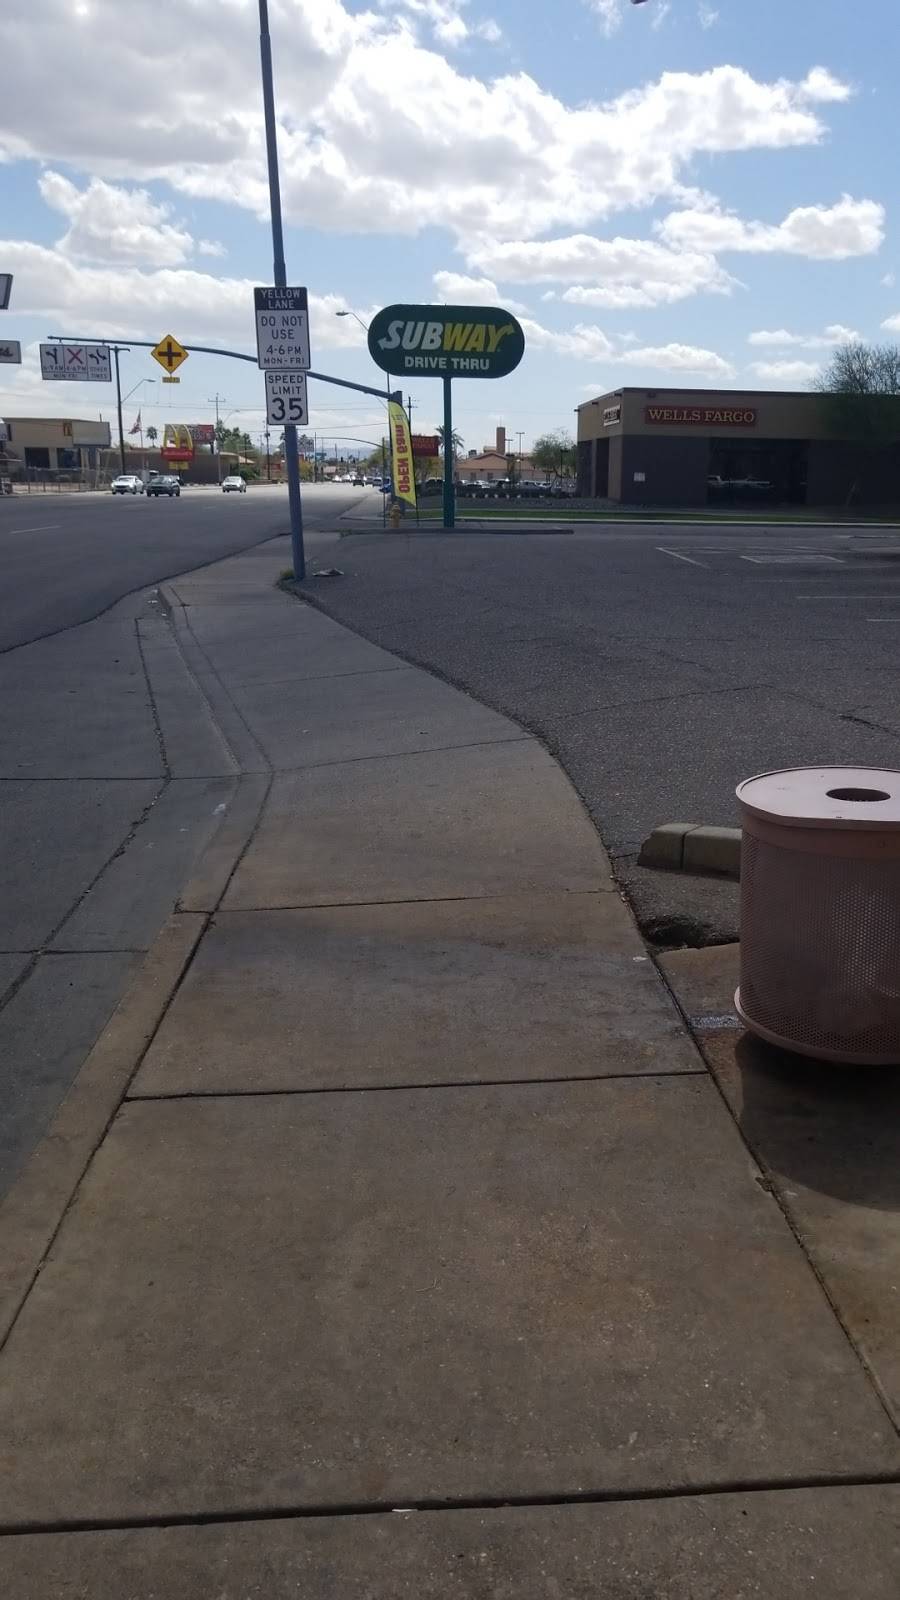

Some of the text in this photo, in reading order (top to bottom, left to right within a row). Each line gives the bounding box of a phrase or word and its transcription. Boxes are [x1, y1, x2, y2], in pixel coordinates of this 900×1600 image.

[261, 289, 300, 299] YELLOW
[268, 300, 294, 309] LANE
[261, 316, 304, 327] DO NOT
[271, 329, 295, 340] USE
[378, 320, 515, 353] SUBWAY
[404, 356, 490, 370] DRIVE THRU
[268, 375, 304, 384] SPEED
[272, 386, 301, 395] LIMIT
[271, 397, 304, 421] 35
[648, 408, 755, 423] WELLS FARGO
